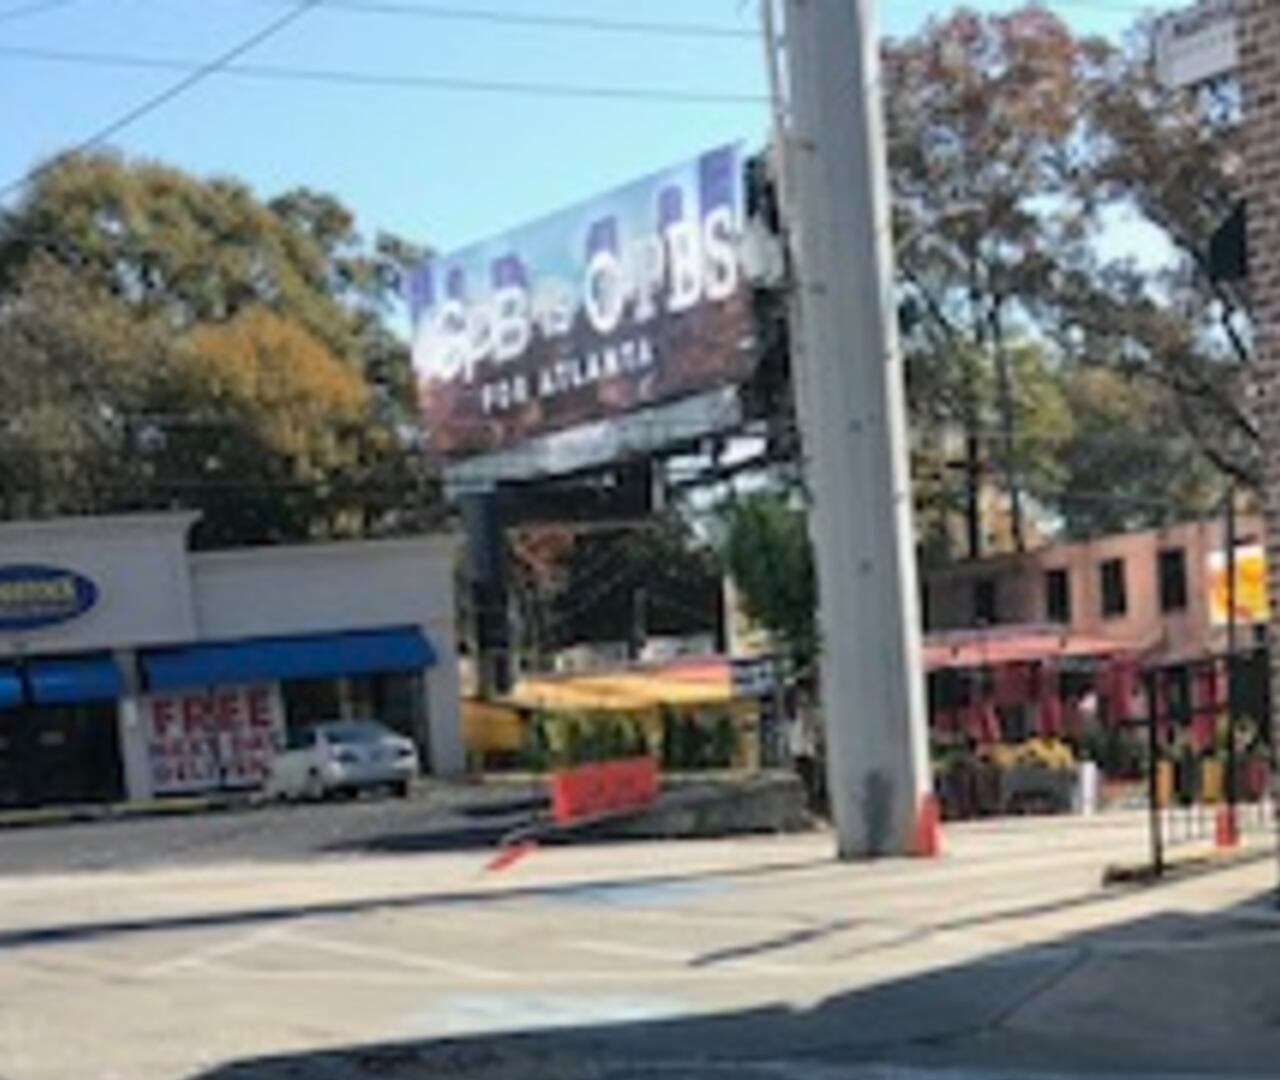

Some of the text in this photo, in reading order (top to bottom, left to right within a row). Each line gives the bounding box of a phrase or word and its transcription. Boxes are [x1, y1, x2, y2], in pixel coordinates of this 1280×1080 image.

[482, 339, 654, 414] FOR ATLANTA
[154, 690, 272, 735] FREE
